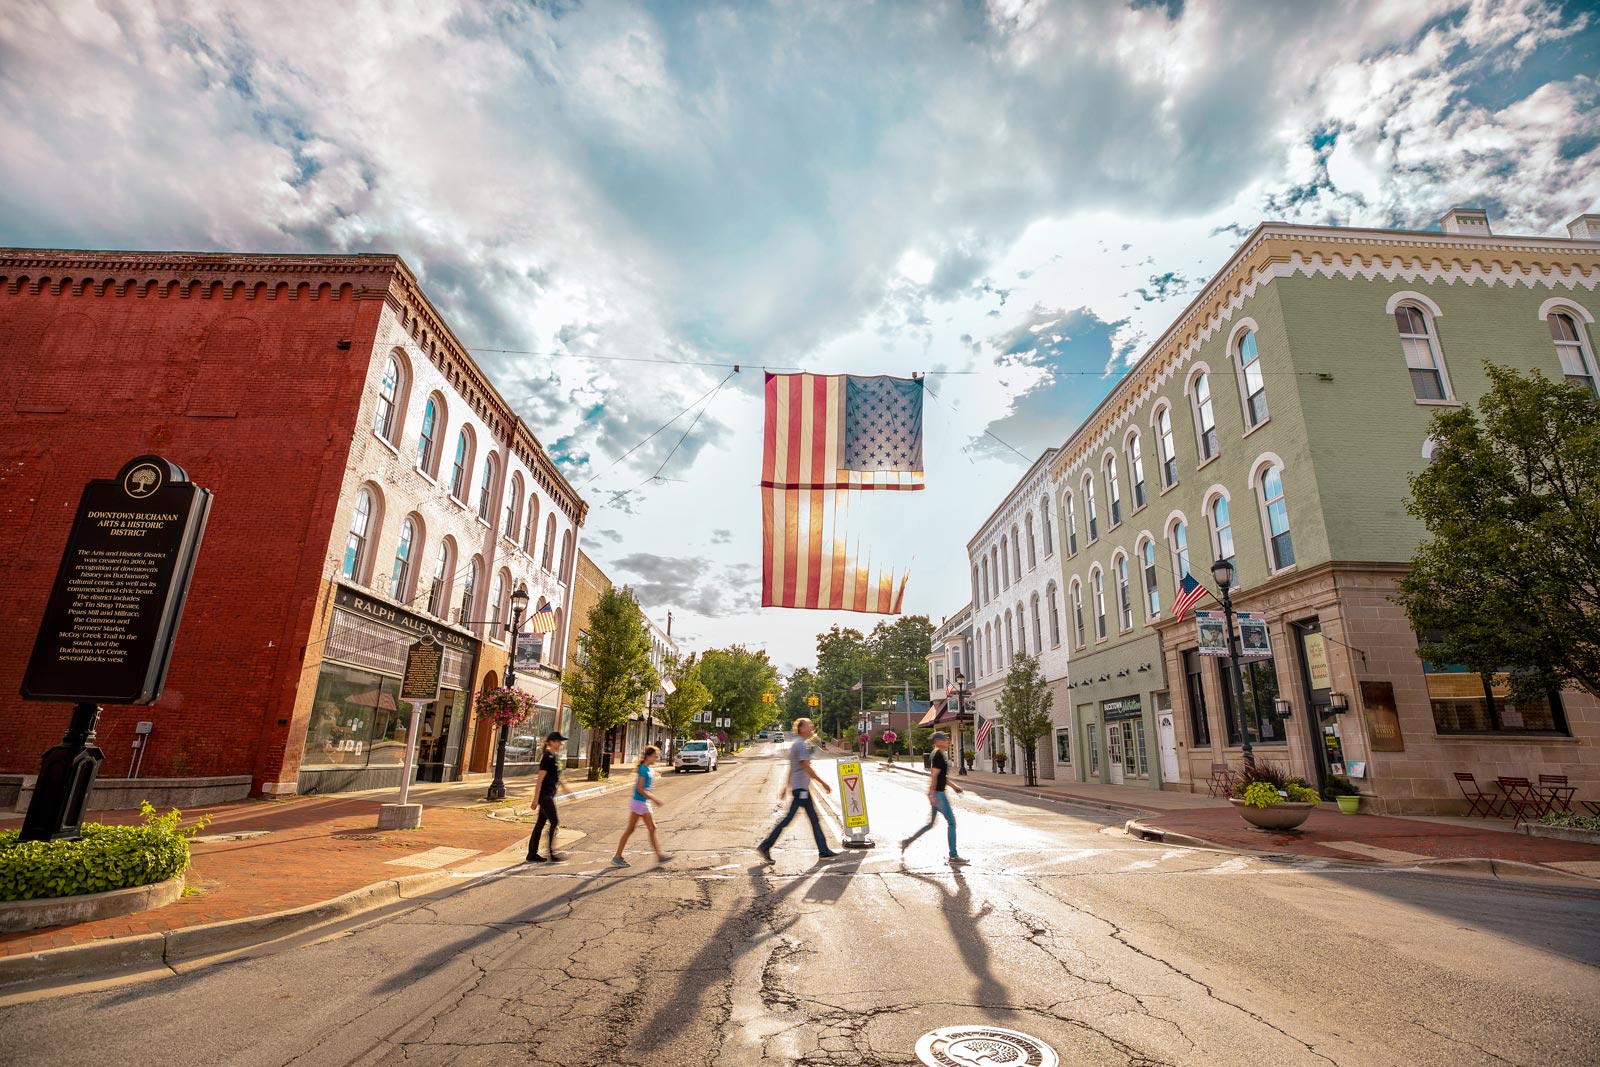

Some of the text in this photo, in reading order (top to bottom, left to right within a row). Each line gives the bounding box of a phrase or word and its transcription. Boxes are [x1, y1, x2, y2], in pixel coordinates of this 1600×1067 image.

[354, 597, 396, 621] RALPH
[400, 617, 434, 635] ALLEN
[447, 633, 465, 646] SON
